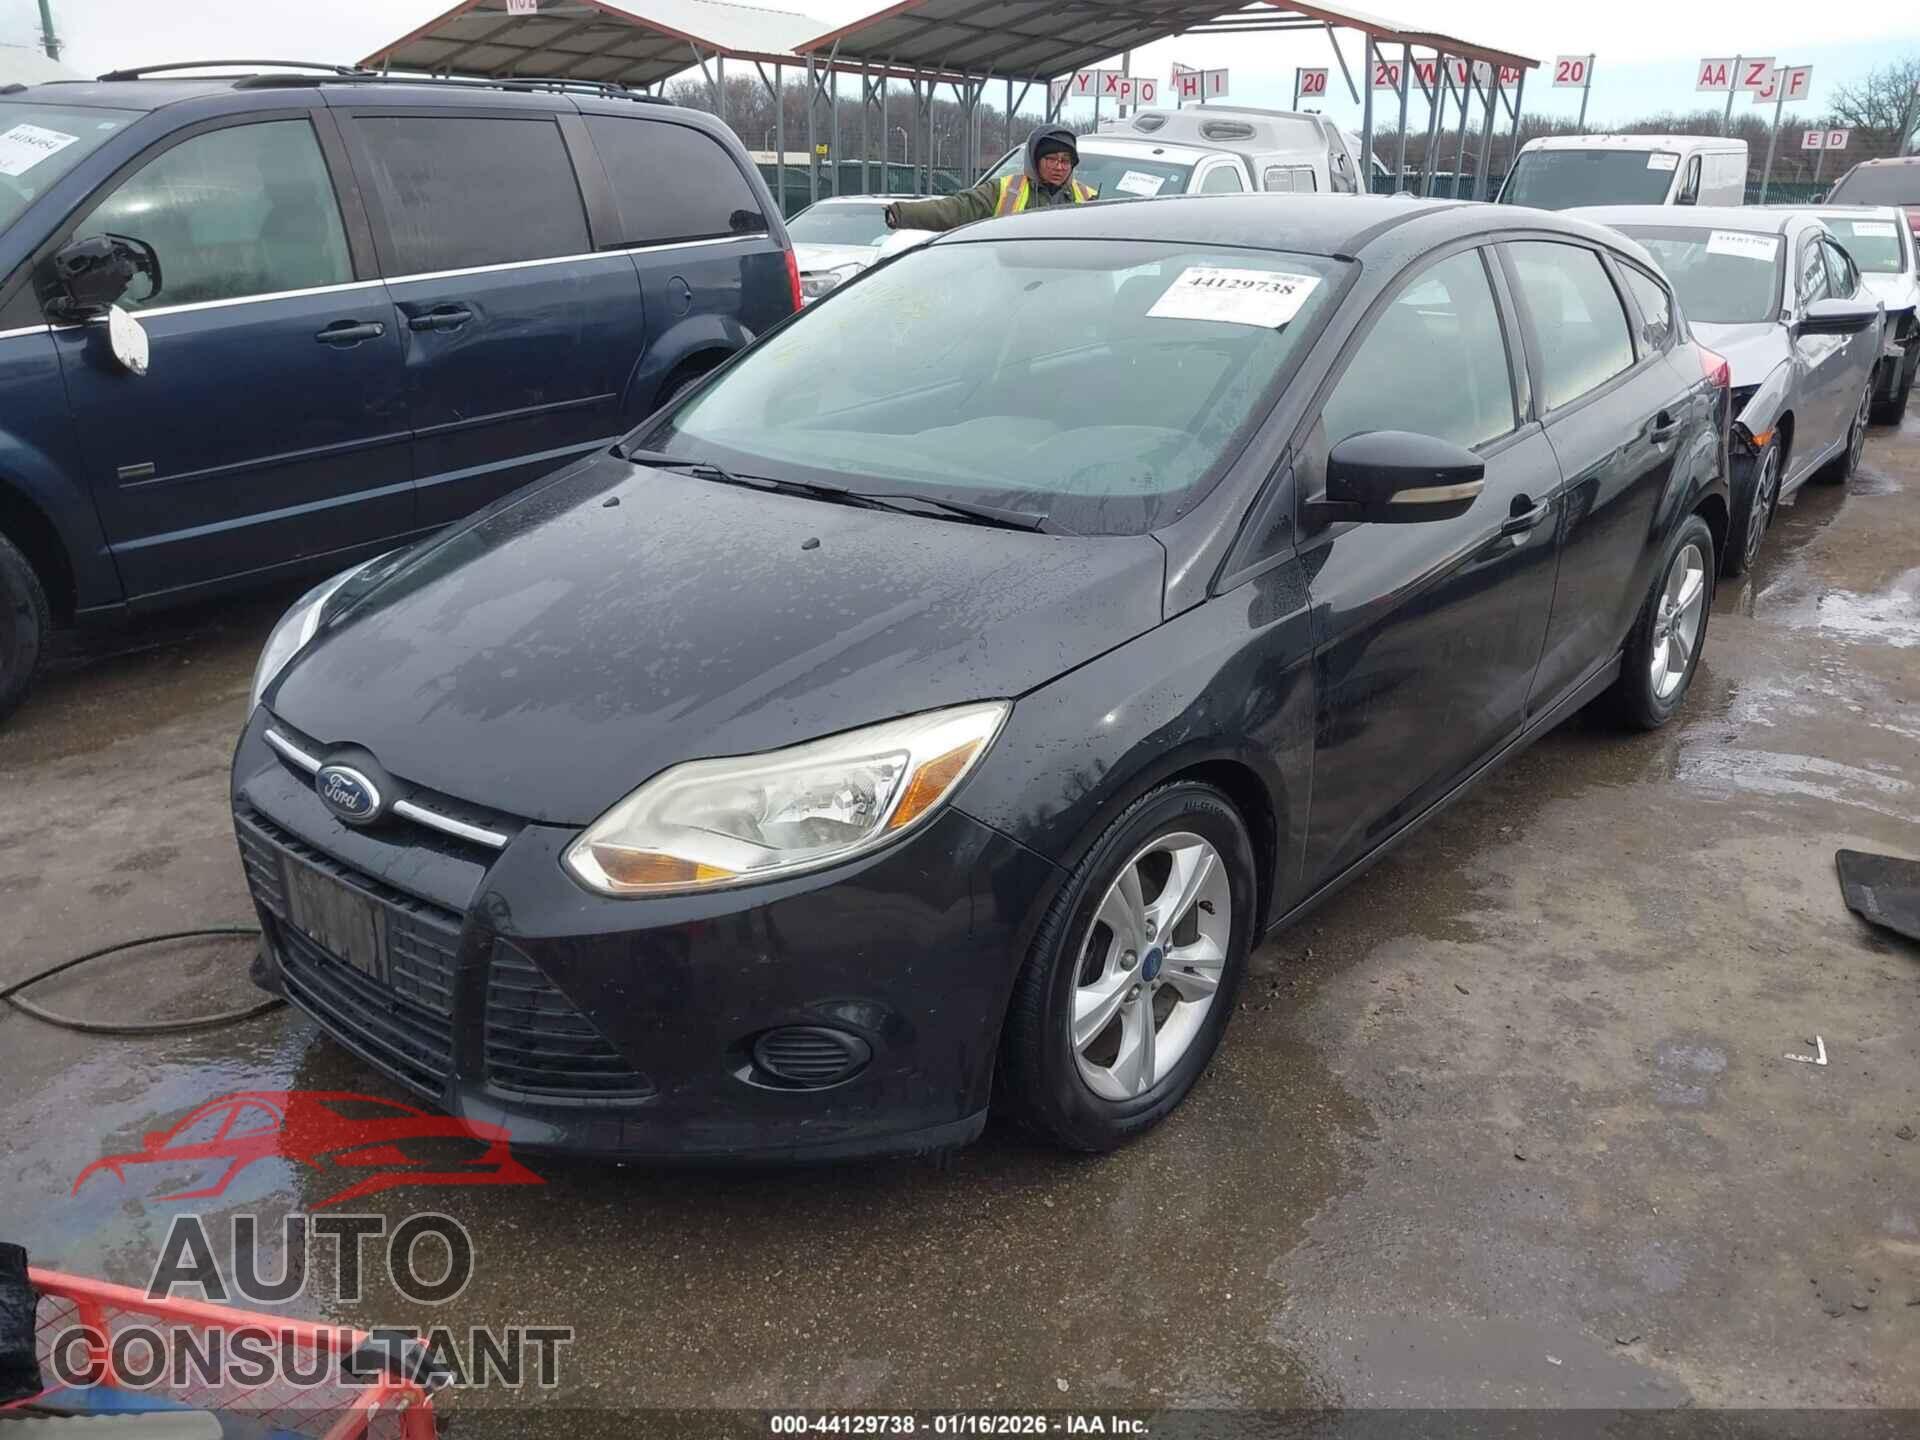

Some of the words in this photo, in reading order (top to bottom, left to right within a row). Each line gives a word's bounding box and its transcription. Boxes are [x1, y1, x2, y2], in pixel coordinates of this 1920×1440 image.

[1375, 65, 1399, 86] 20
[1556, 61, 1584, 82] 20
[1700, 64, 1727, 85] AA
[1745, 63, 1765, 85] Z
[1078, 74, 1089, 91] Y
[1105, 74, 1118, 91] X
[1120, 82, 1131, 99] P
[1142, 83, 1154, 101] O
[1183, 78, 1197, 96] H
[1303, 73, 1326, 92] 20
[1790, 72, 1804, 94] F
[1807, 133, 1818, 146] E
[1831, 133, 1843, 146] D
[1189, 276, 1296, 295] 44129738
[324, 773, 360, 809] Ford
